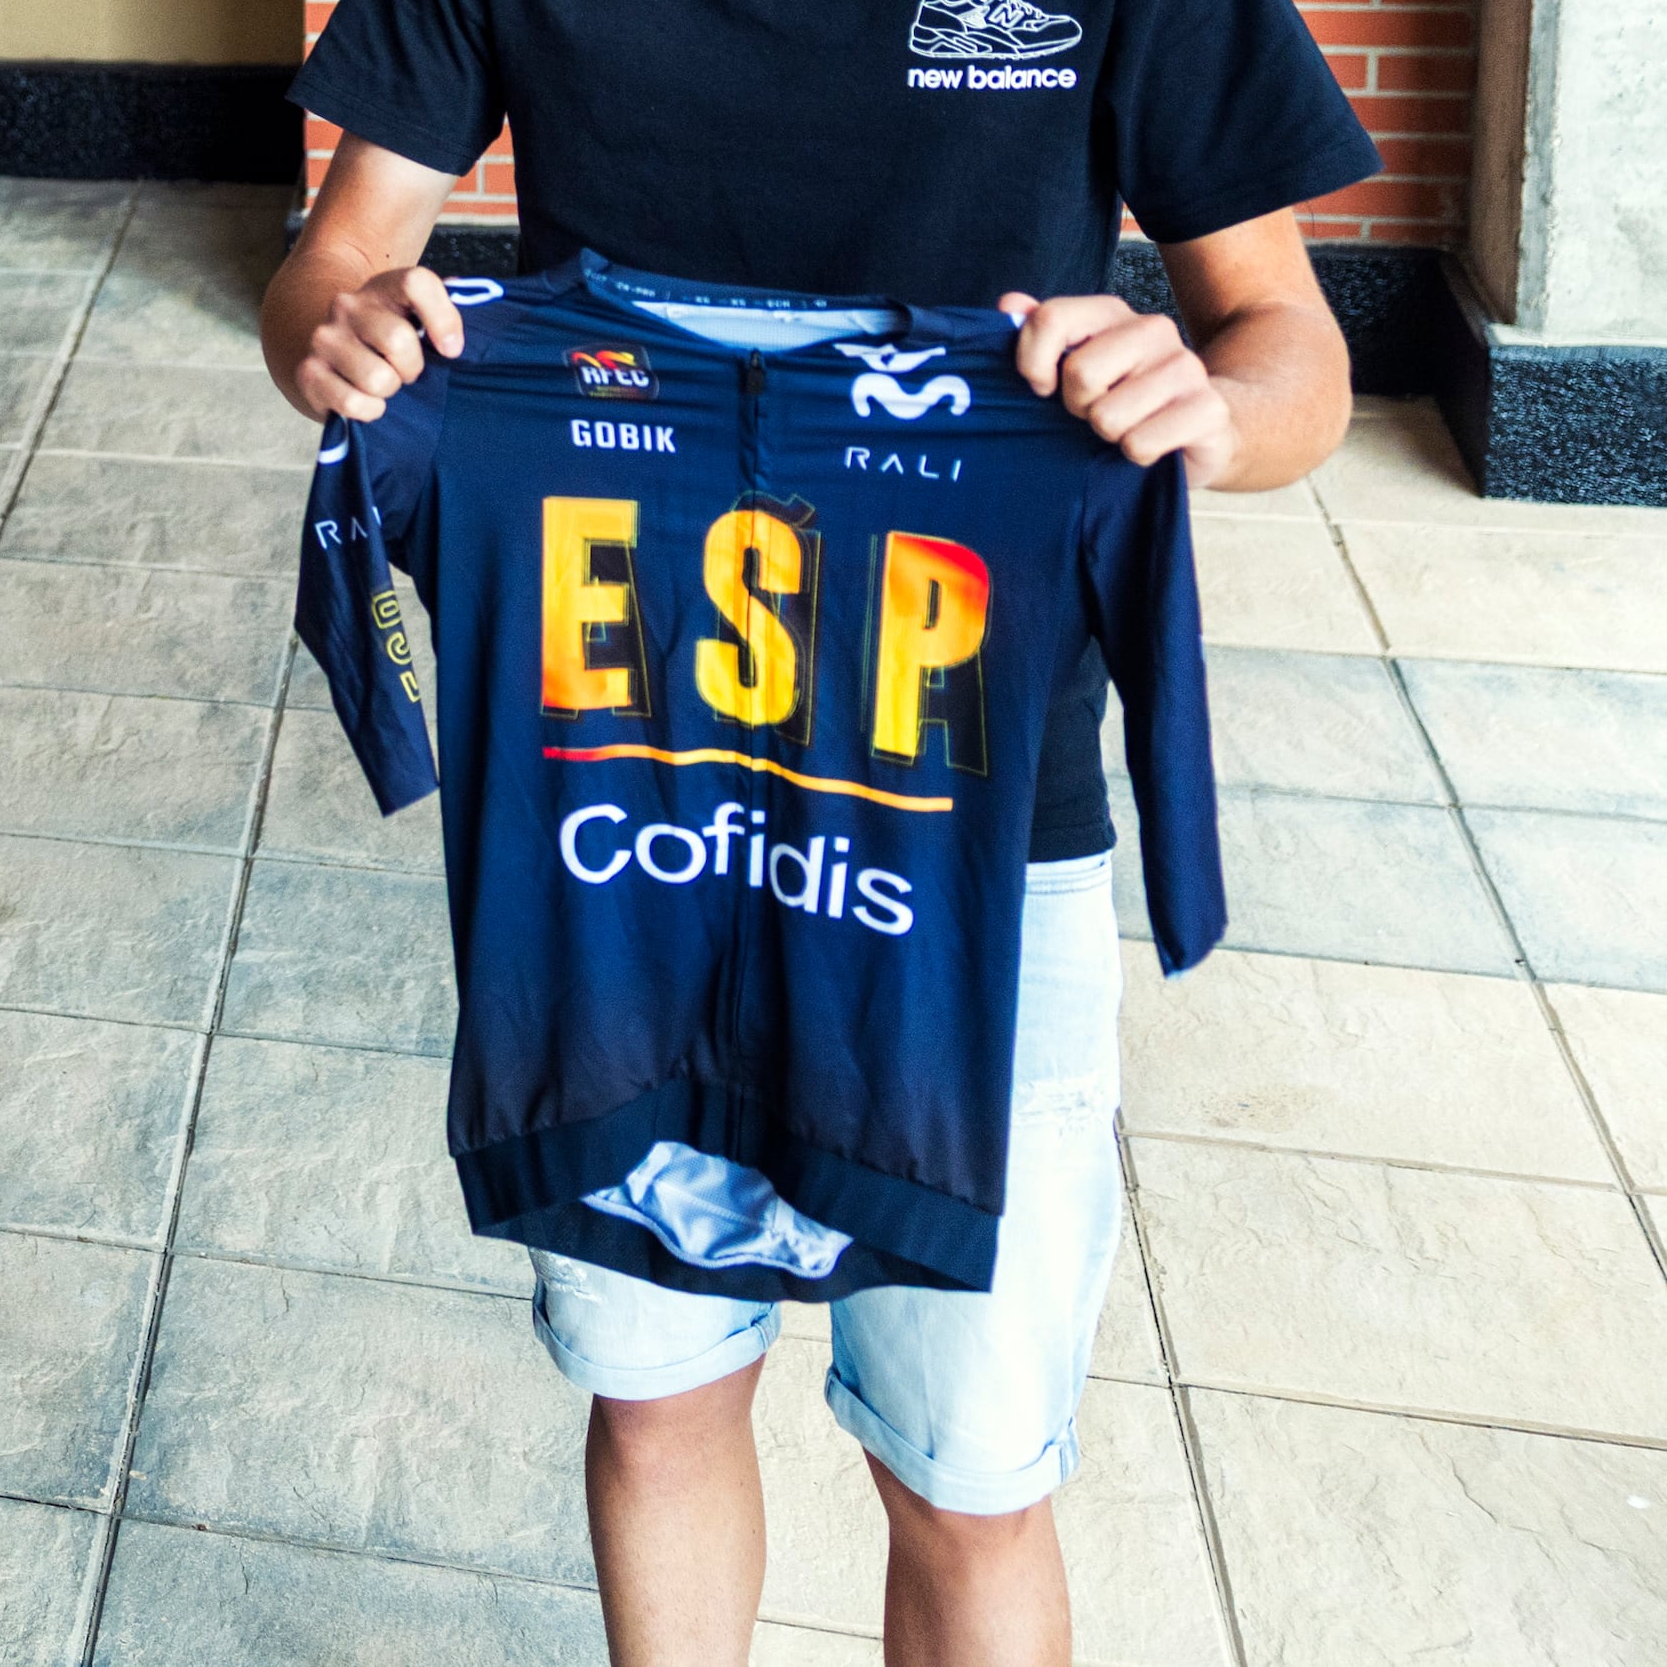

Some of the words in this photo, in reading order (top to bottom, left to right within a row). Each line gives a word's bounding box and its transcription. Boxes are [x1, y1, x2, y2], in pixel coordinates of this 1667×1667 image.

[907, 68, 963, 89] new
[967, 64, 1077, 90] balance
[570, 419, 677, 453] GOBIK
[844, 445, 962, 483] RALI
[541, 495, 990, 759] ESP
[559, 801, 914, 936] Cofidis
